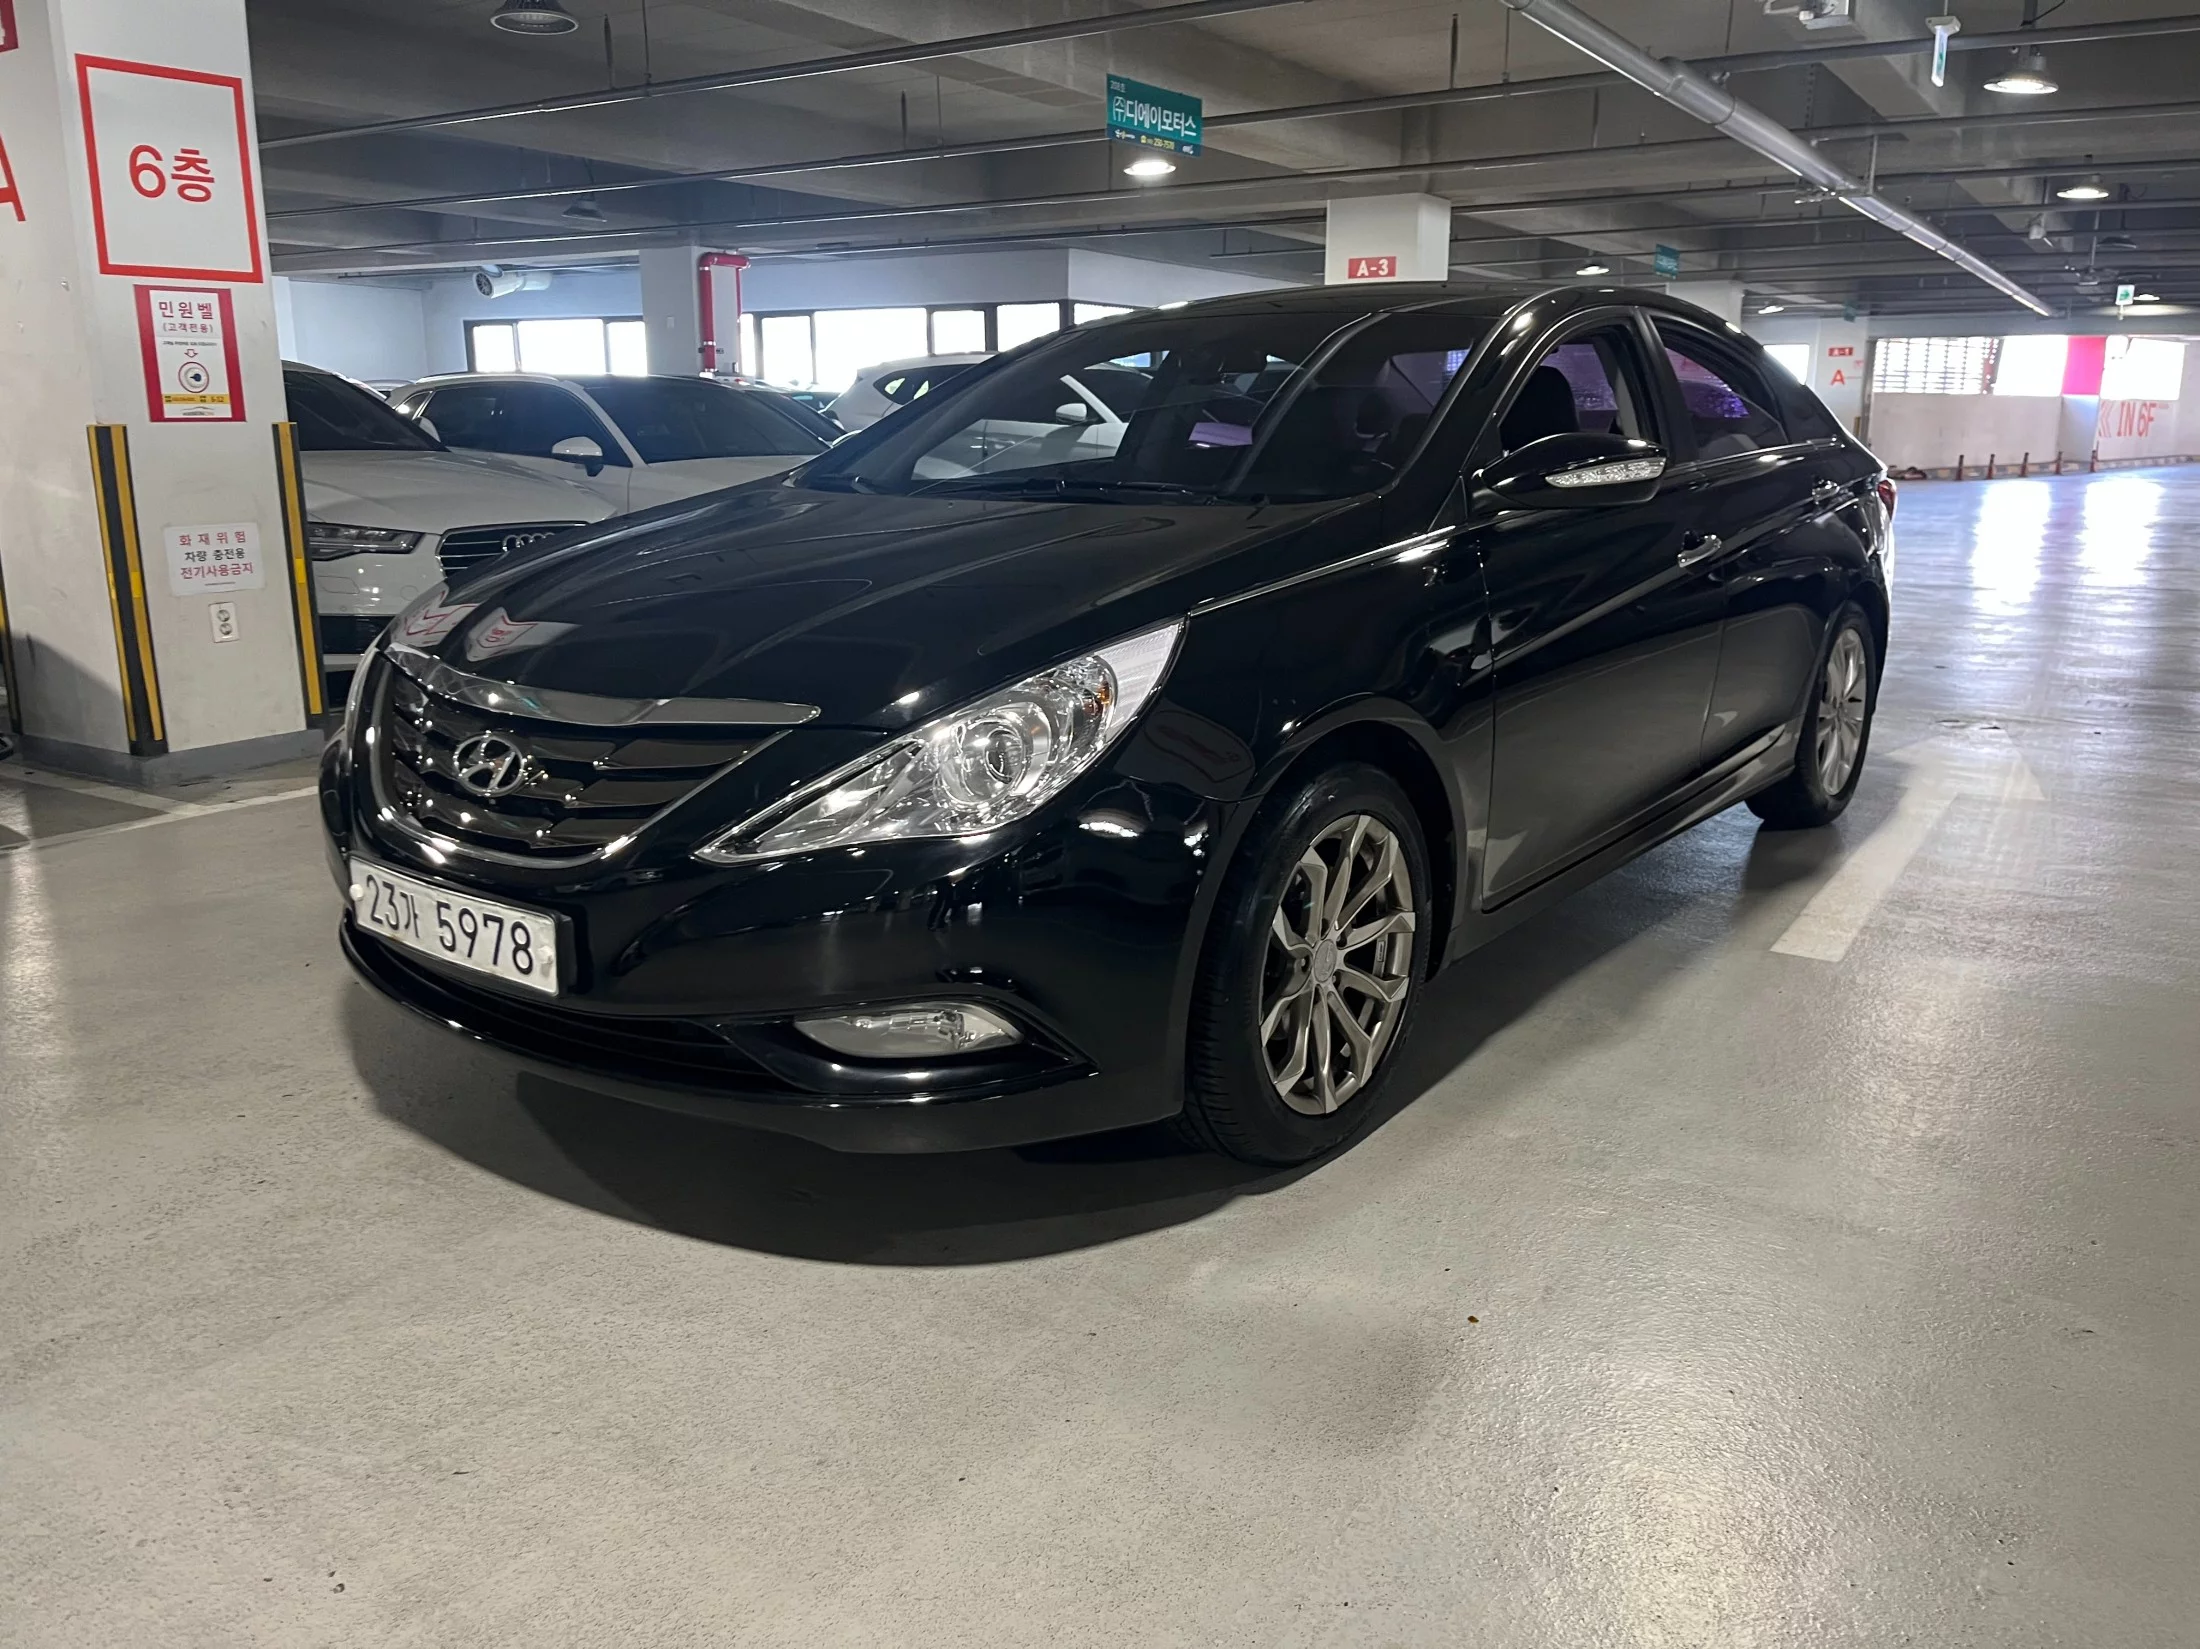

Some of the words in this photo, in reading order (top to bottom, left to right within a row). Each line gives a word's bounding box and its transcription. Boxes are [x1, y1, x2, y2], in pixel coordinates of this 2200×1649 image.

[129, 144, 214, 203] 6층
[1357, 259, 1389, 277] A-3
[1830, 369, 1845, 386] A
[2117, 402, 2136, 437] IN
[2138, 402, 2157, 437] 6F
[180, 562, 253, 580] 전기사용금지
[366, 874, 420, 939] 23가
[436, 901, 534, 976] 5978
